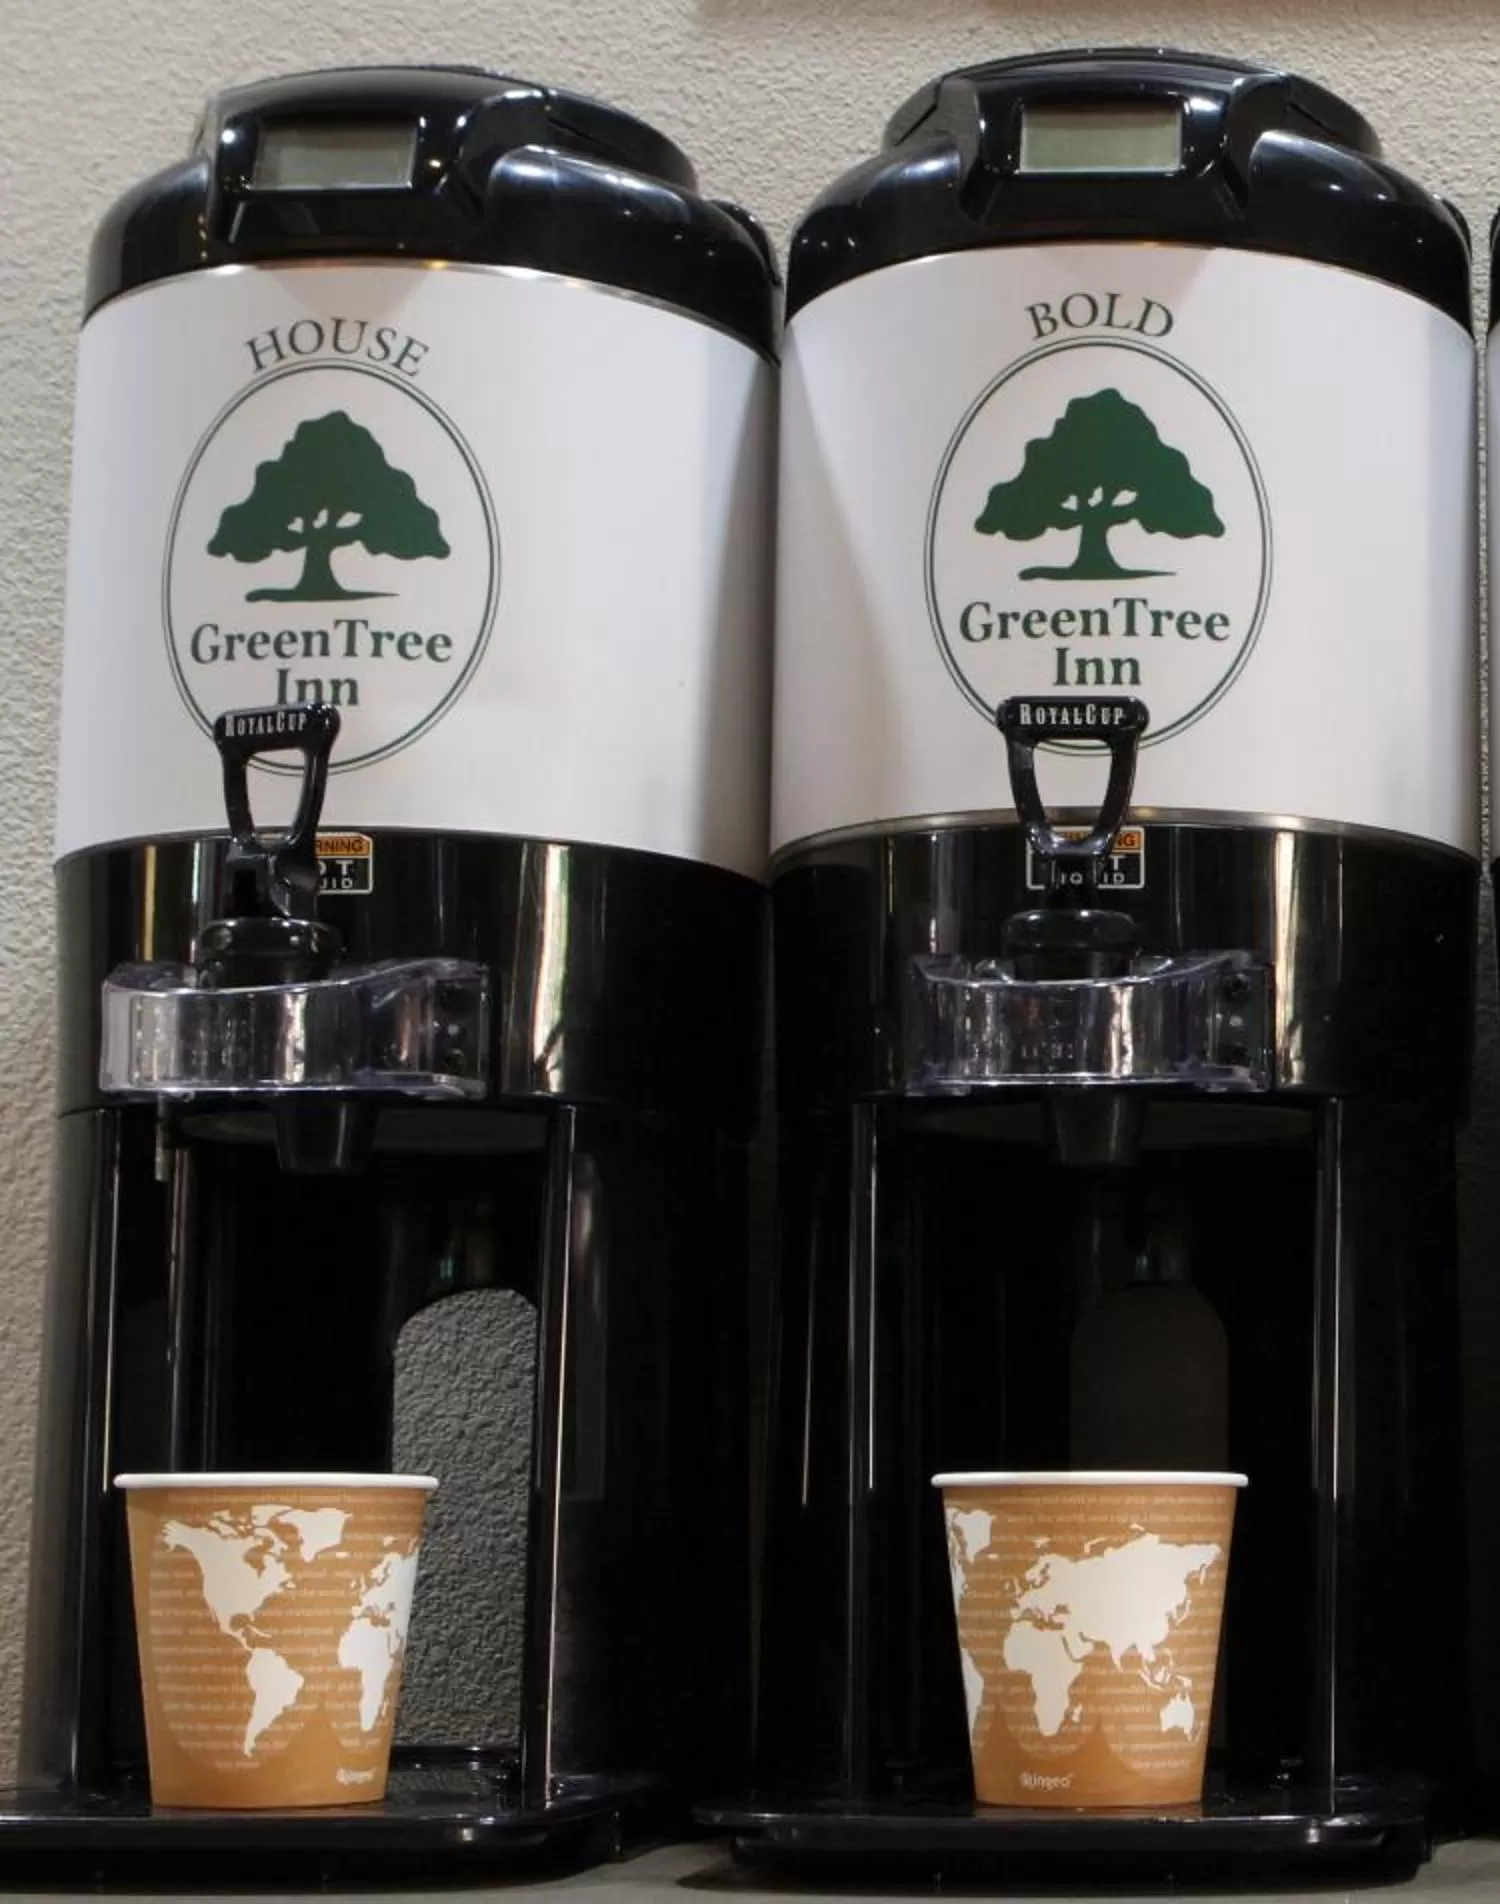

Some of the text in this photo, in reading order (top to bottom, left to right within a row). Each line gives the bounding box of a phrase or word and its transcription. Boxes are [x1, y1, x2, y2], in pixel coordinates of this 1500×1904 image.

[1025, 292, 1174, 340] BOLD
[245, 318, 430, 378] HOUSE
[959, 597, 1231, 643] GreenTree
[190, 619, 454, 665] GreenTree
[276, 667, 360, 706] Inn
[1052, 647, 1142, 687] Inn
[317, 838, 364, 853] NING
[319, 877, 353, 889] UID
[1061, 871, 1126, 886] IQID
